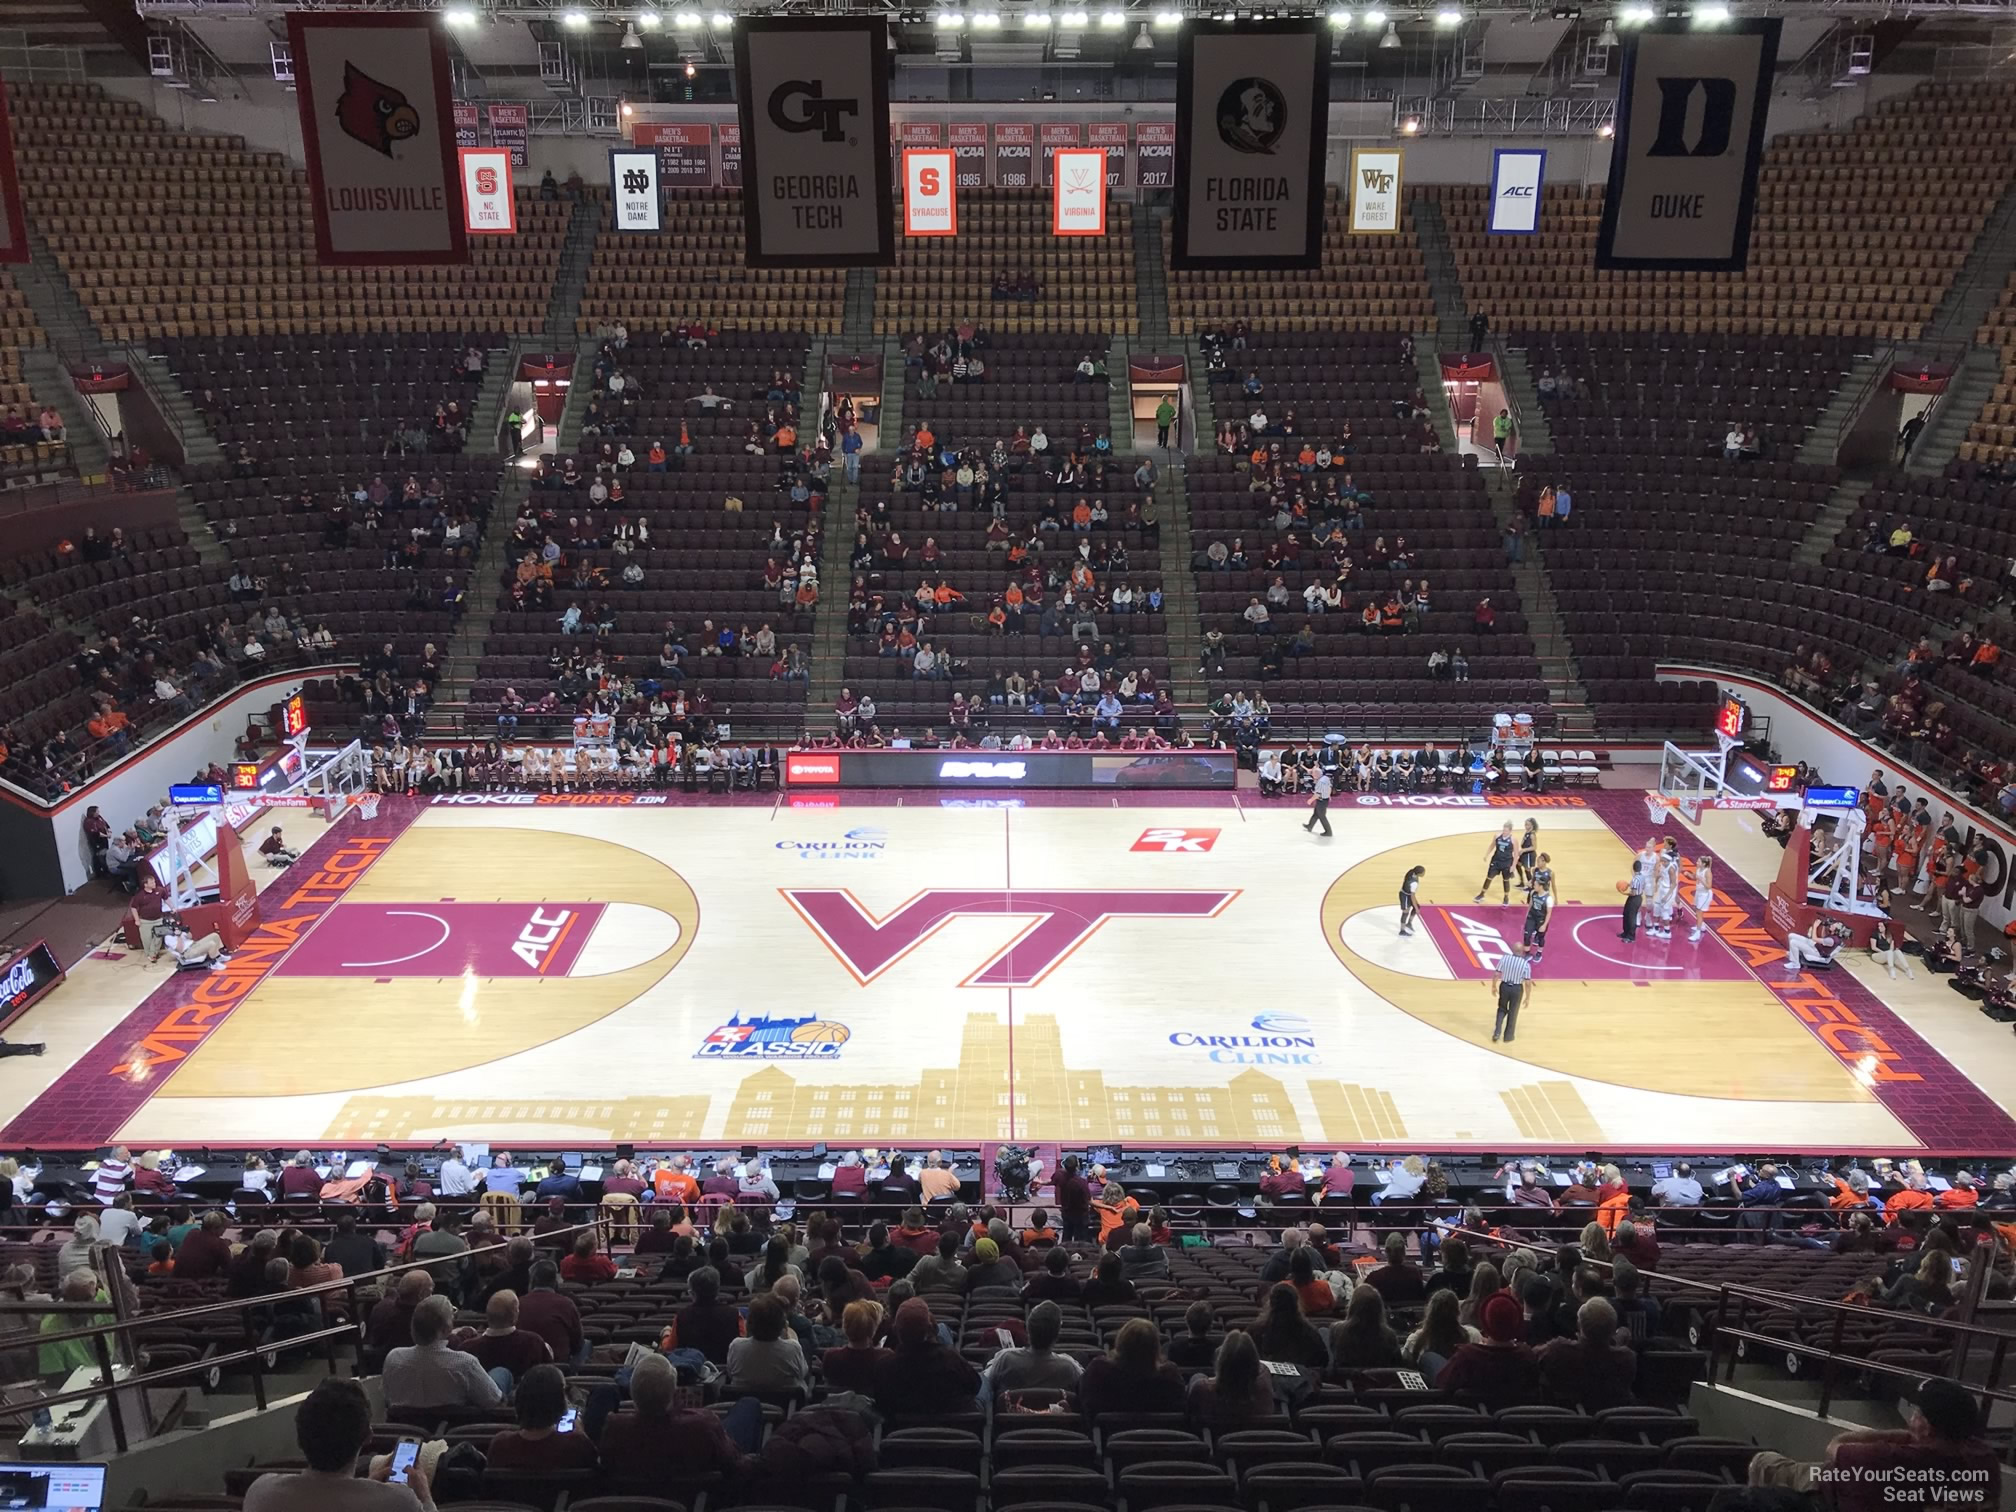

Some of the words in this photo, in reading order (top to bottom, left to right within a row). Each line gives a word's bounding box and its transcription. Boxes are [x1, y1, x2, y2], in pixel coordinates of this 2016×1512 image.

[498, 109, 517, 117] MEN'S
[662, 127, 682, 135] MEN'S
[912, 127, 931, 135] MEN'S
[959, 127, 978, 135] MEN'S
[1005, 127, 1024, 135] MEN'S
[1051, 127, 1070, 135] MEN'S
[1098, 127, 1117, 135] MEN'S
[1147, 126, 1166, 134] MEN'S
[655, 135, 690, 143] BASKETBALL
[998, 146, 1031, 157] NCAA
[1139, 146, 1172, 157] NCAA
[511, 153, 523, 165] 96
[722, 161, 738, 170] 1973
[957, 173, 981, 185] 1985
[1002, 173, 1026, 185] 1986
[1143, 172, 1167, 184] 2017
[773, 175, 860, 199] GEORGIA
[1206, 177, 1290, 201] FLORIDA
[1503, 186, 1534, 196] ACC
[327, 187, 444, 211] LOUISVILLE
[484, 202, 494, 210] NC
[626, 202, 649, 211] NOTRE
[1365, 202, 1385, 211] WAKE
[1650, 194, 1705, 219] DUKE
[479, 212, 499, 220] STATE
[628, 212, 648, 221] DAME
[912, 208, 949, 217] SYRACUSE
[1064, 208, 1096, 216] VIRGINIA
[1362, 212, 1388, 221] FOREST
[792, 206, 843, 229] TECH
[1216, 207, 1278, 231] STATE
[240, 766, 257, 775] 7:43
[803, 766, 834, 774] TOYOTA
[1777, 767, 1796, 777] 7:43
[238, 775, 253, 786] 30
[1774, 776, 1789, 789] 30
[775, 840, 886, 850] CARILION
[1141, 829, 1211, 851] 2K
[799, 850, 883, 859] CLINIC
[281, 836, 392, 909] TECH
[511, 905, 572, 969] ACC
[776, 888, 1245, 988] VT
[11, 991, 28, 1007] zero
[109, 913, 321, 1076] VIRGINIA
[1768, 973, 1924, 1081] TECH
[1169, 1032, 1317, 1049] CARILION
[698, 1042, 842, 1055] CLASSIC
[1208, 1050, 1323, 1065] CLINIC
